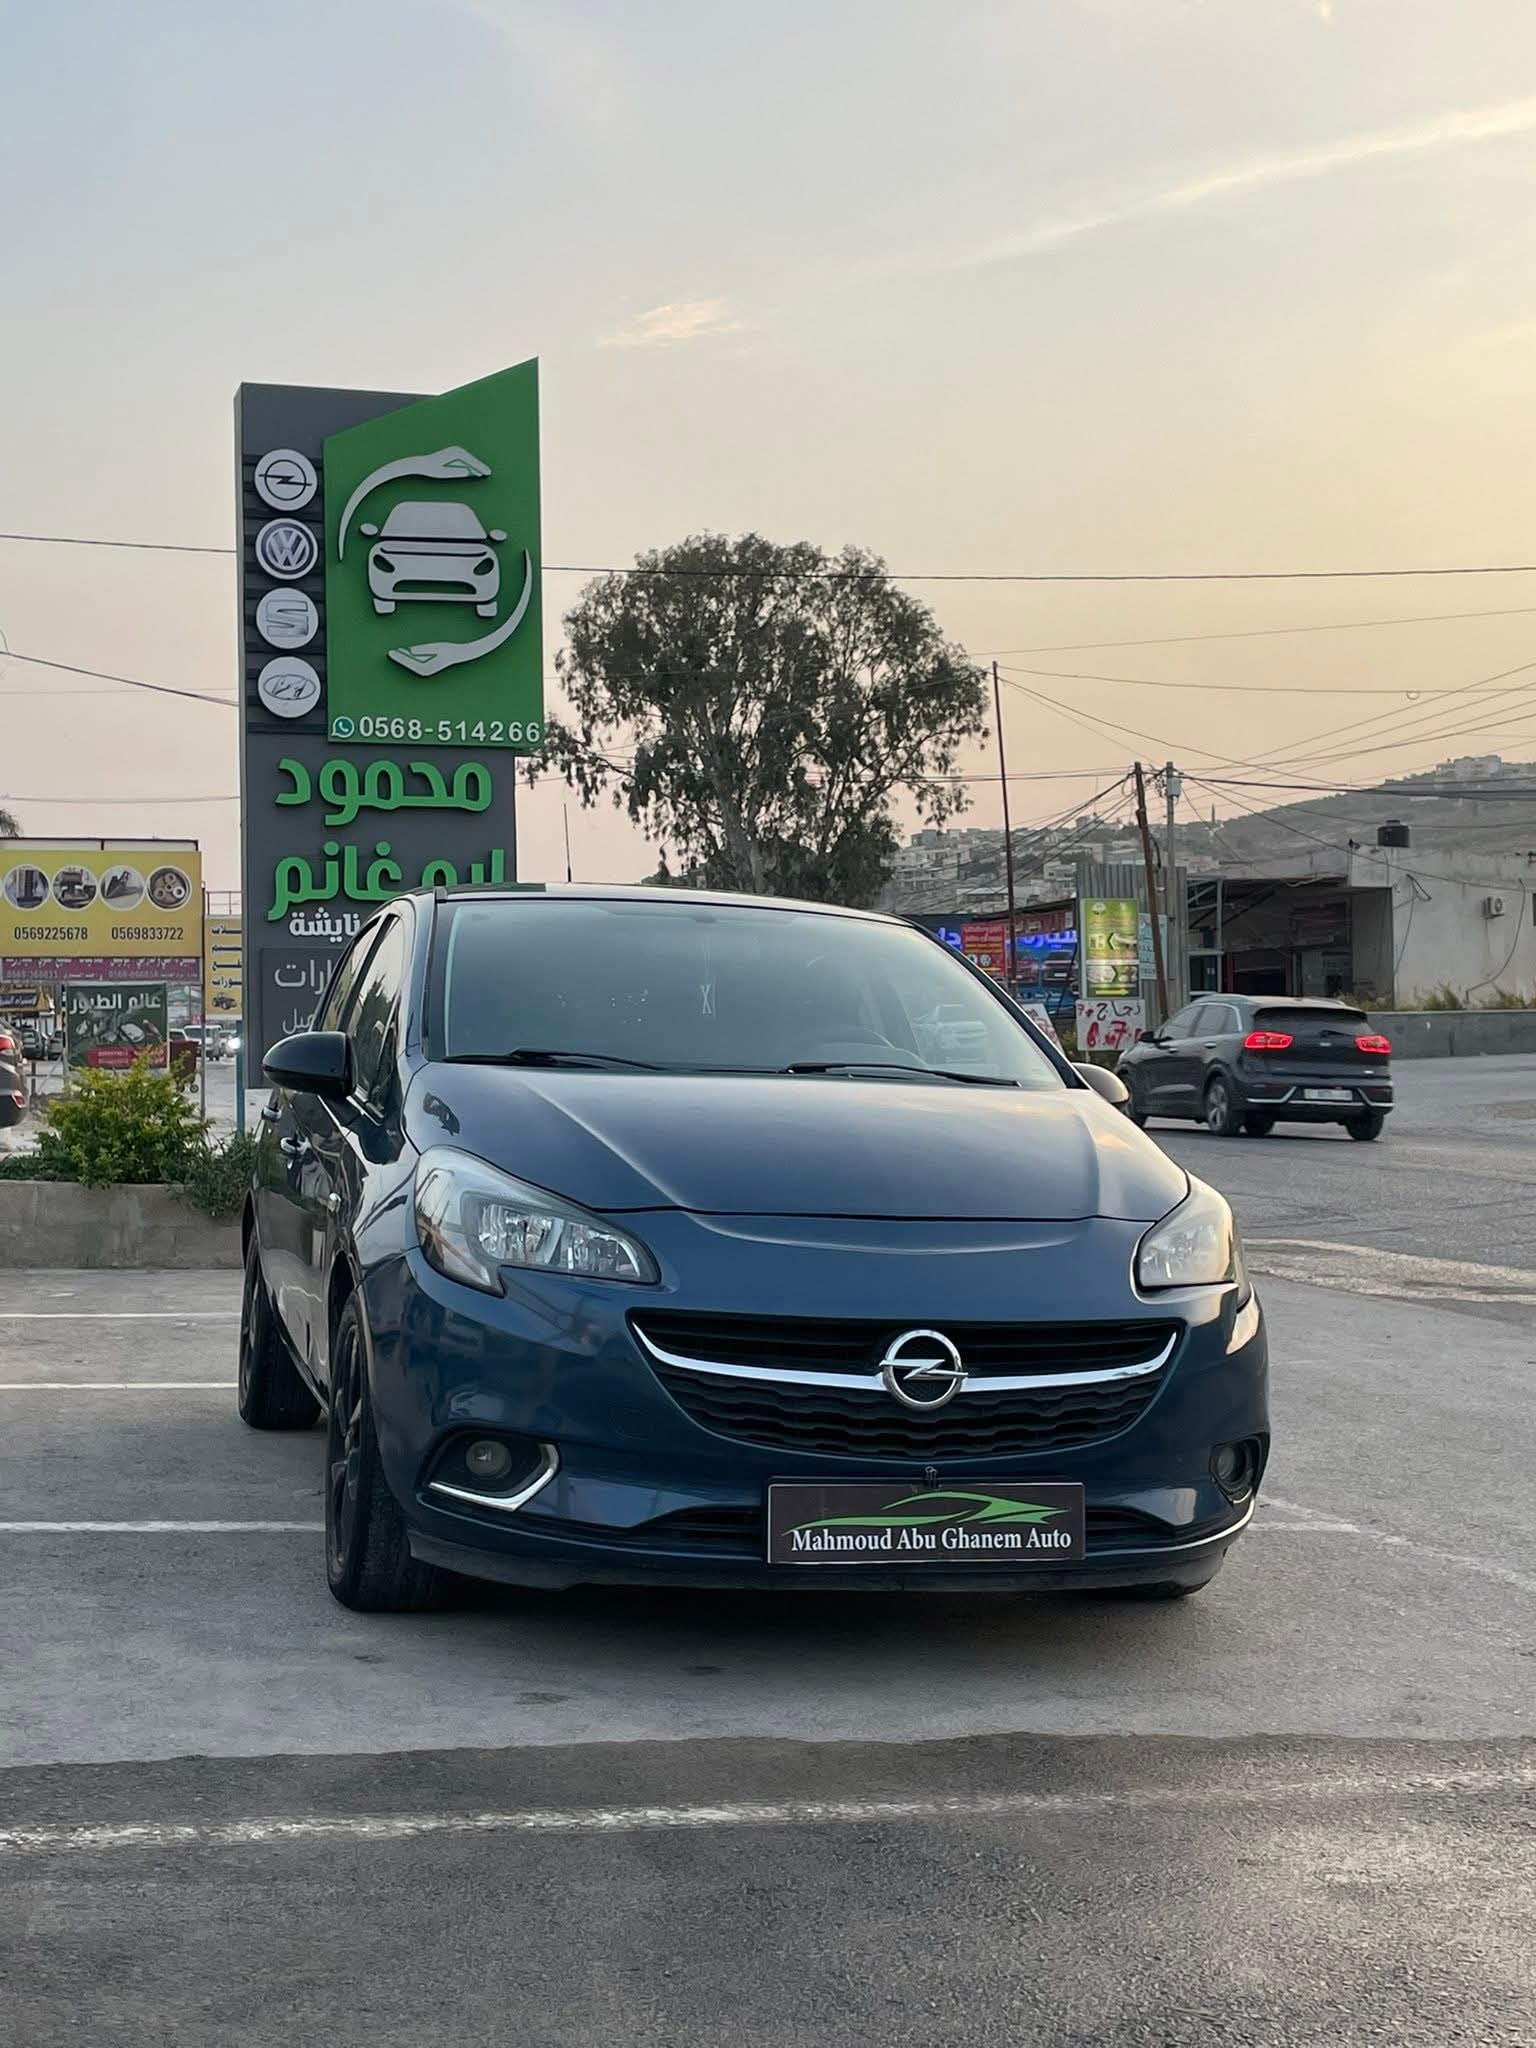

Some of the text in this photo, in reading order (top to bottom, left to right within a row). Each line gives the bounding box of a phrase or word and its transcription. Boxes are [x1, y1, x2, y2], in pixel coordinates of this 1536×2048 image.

[359, 717, 541, 743] 0568-514266
[275, 758, 493, 826] محمود
[267, 841, 402, 921] غانم
[14, 926, 184, 941] 0569225678 0569833722
[69, 992, 161, 1015] عالم الطيور
[791, 1527, 1072, 1551] Mahmoud Abu Ghanem Auto
